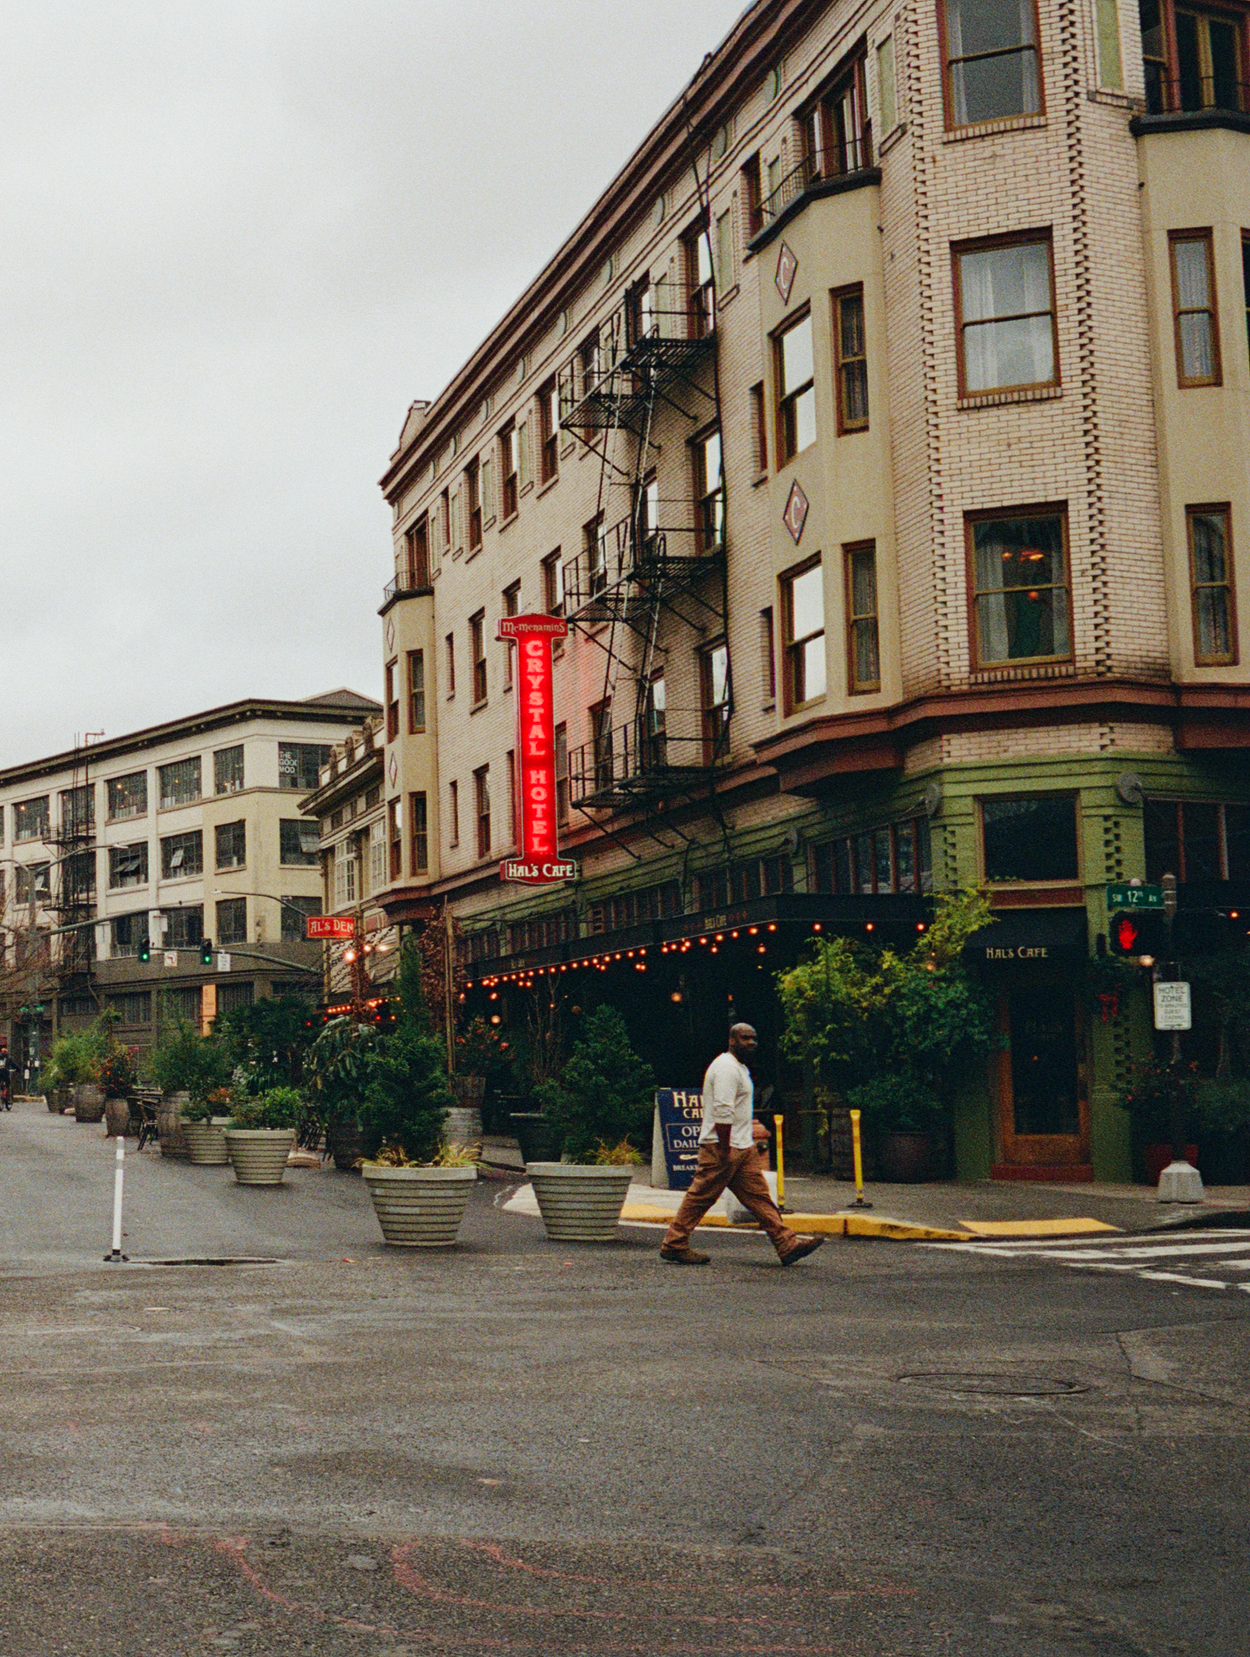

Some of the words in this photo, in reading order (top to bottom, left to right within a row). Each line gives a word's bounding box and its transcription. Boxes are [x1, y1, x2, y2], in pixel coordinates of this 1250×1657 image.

[526, 640, 545, 755] CRYSTAL
[530, 770, 548, 851] HOTEL
[509, 863, 539, 877] HAL'S
[543, 863, 573, 877] CAFE
[311, 921, 330, 933] AL'S
[333, 919, 354, 932] DEN
[1017, 946, 1048, 958] CAFE
[1158, 986, 1186, 995] HOTEL
[674, 1139, 699, 1149] DAIL
